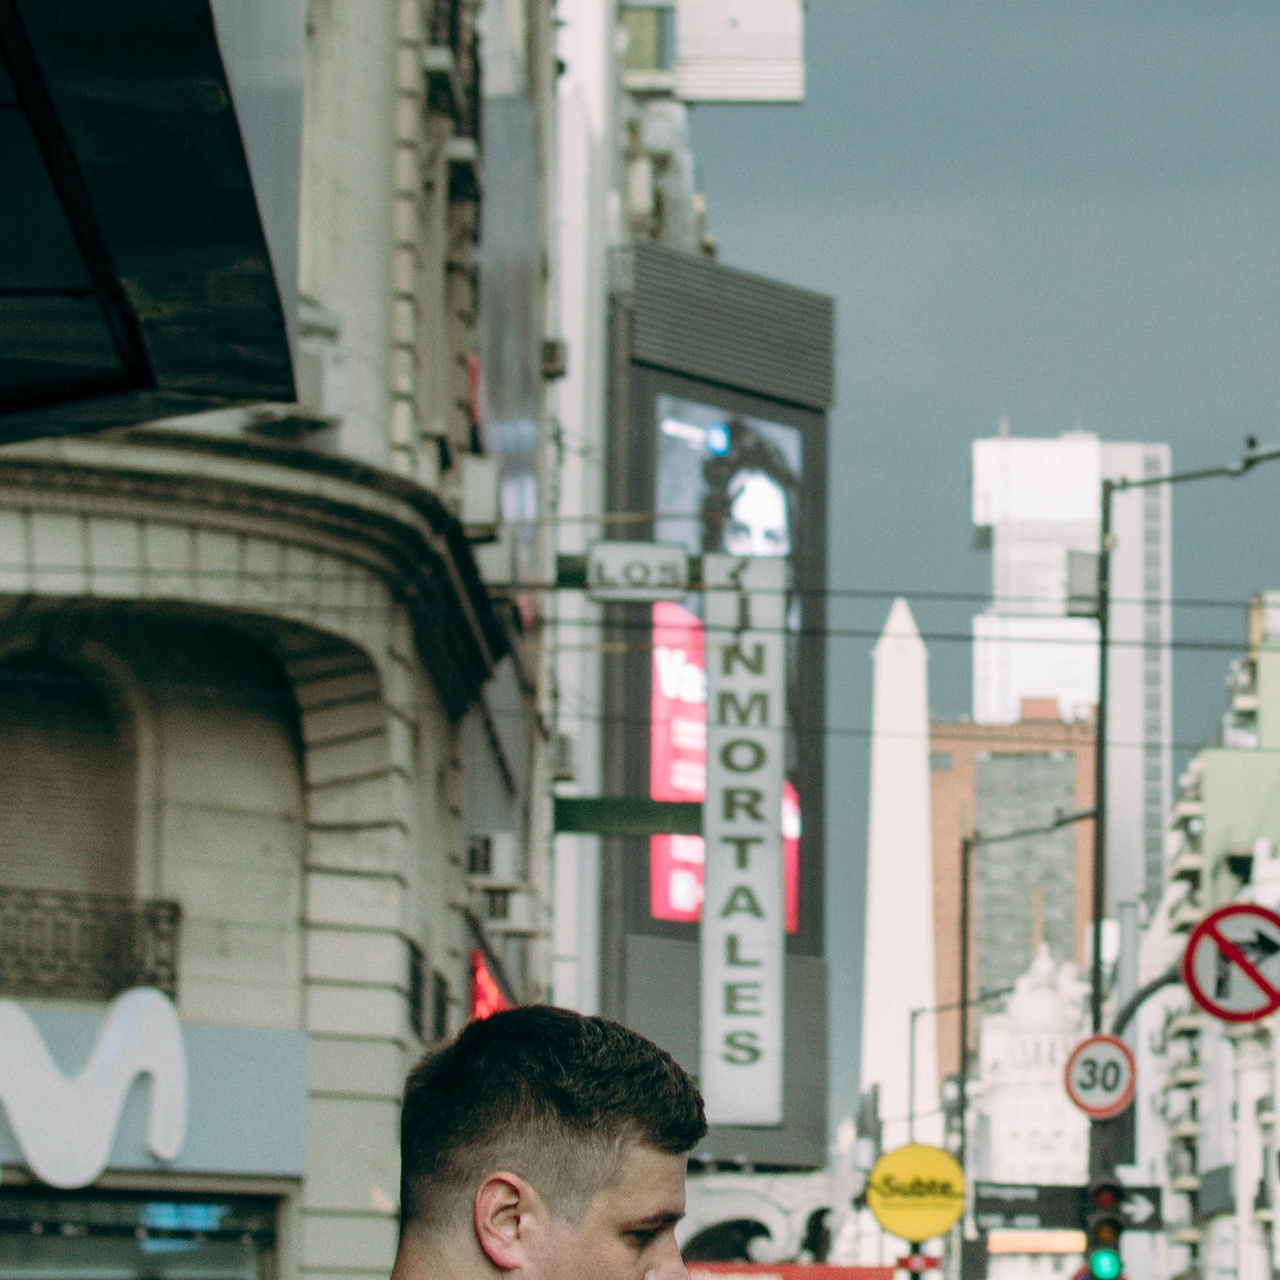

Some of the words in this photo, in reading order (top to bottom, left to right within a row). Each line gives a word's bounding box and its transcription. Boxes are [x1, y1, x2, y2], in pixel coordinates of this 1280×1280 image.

[598, 562, 680, 589] LOS
[717, 590, 770, 1067] INMORTALES
[1078, 1057, 1122, 1094] 30
